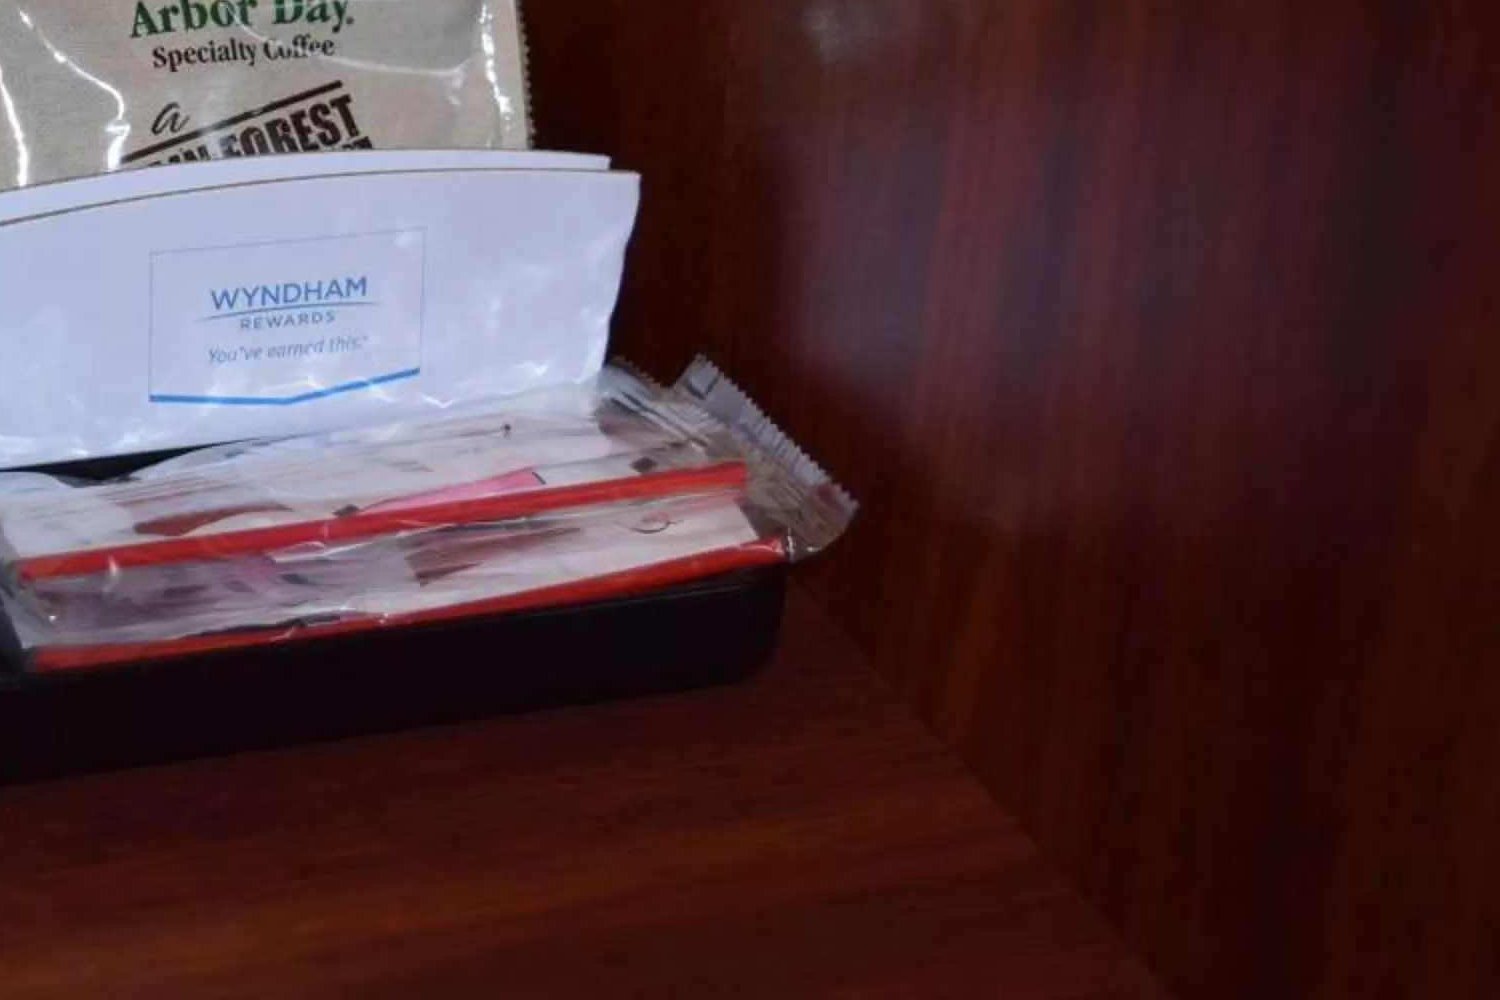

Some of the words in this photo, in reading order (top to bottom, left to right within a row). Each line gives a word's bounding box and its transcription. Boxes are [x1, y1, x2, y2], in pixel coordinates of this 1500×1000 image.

[152, 38, 258, 73] Specialty
[263, 33, 336, 62] Coffee
[219, 93, 362, 158] FOREST
[209, 275, 368, 311] WYNDHAM
[239, 311, 337, 332] REWARDS
[207, 345, 263, 364] You've
[267, 337, 325, 359] earned
